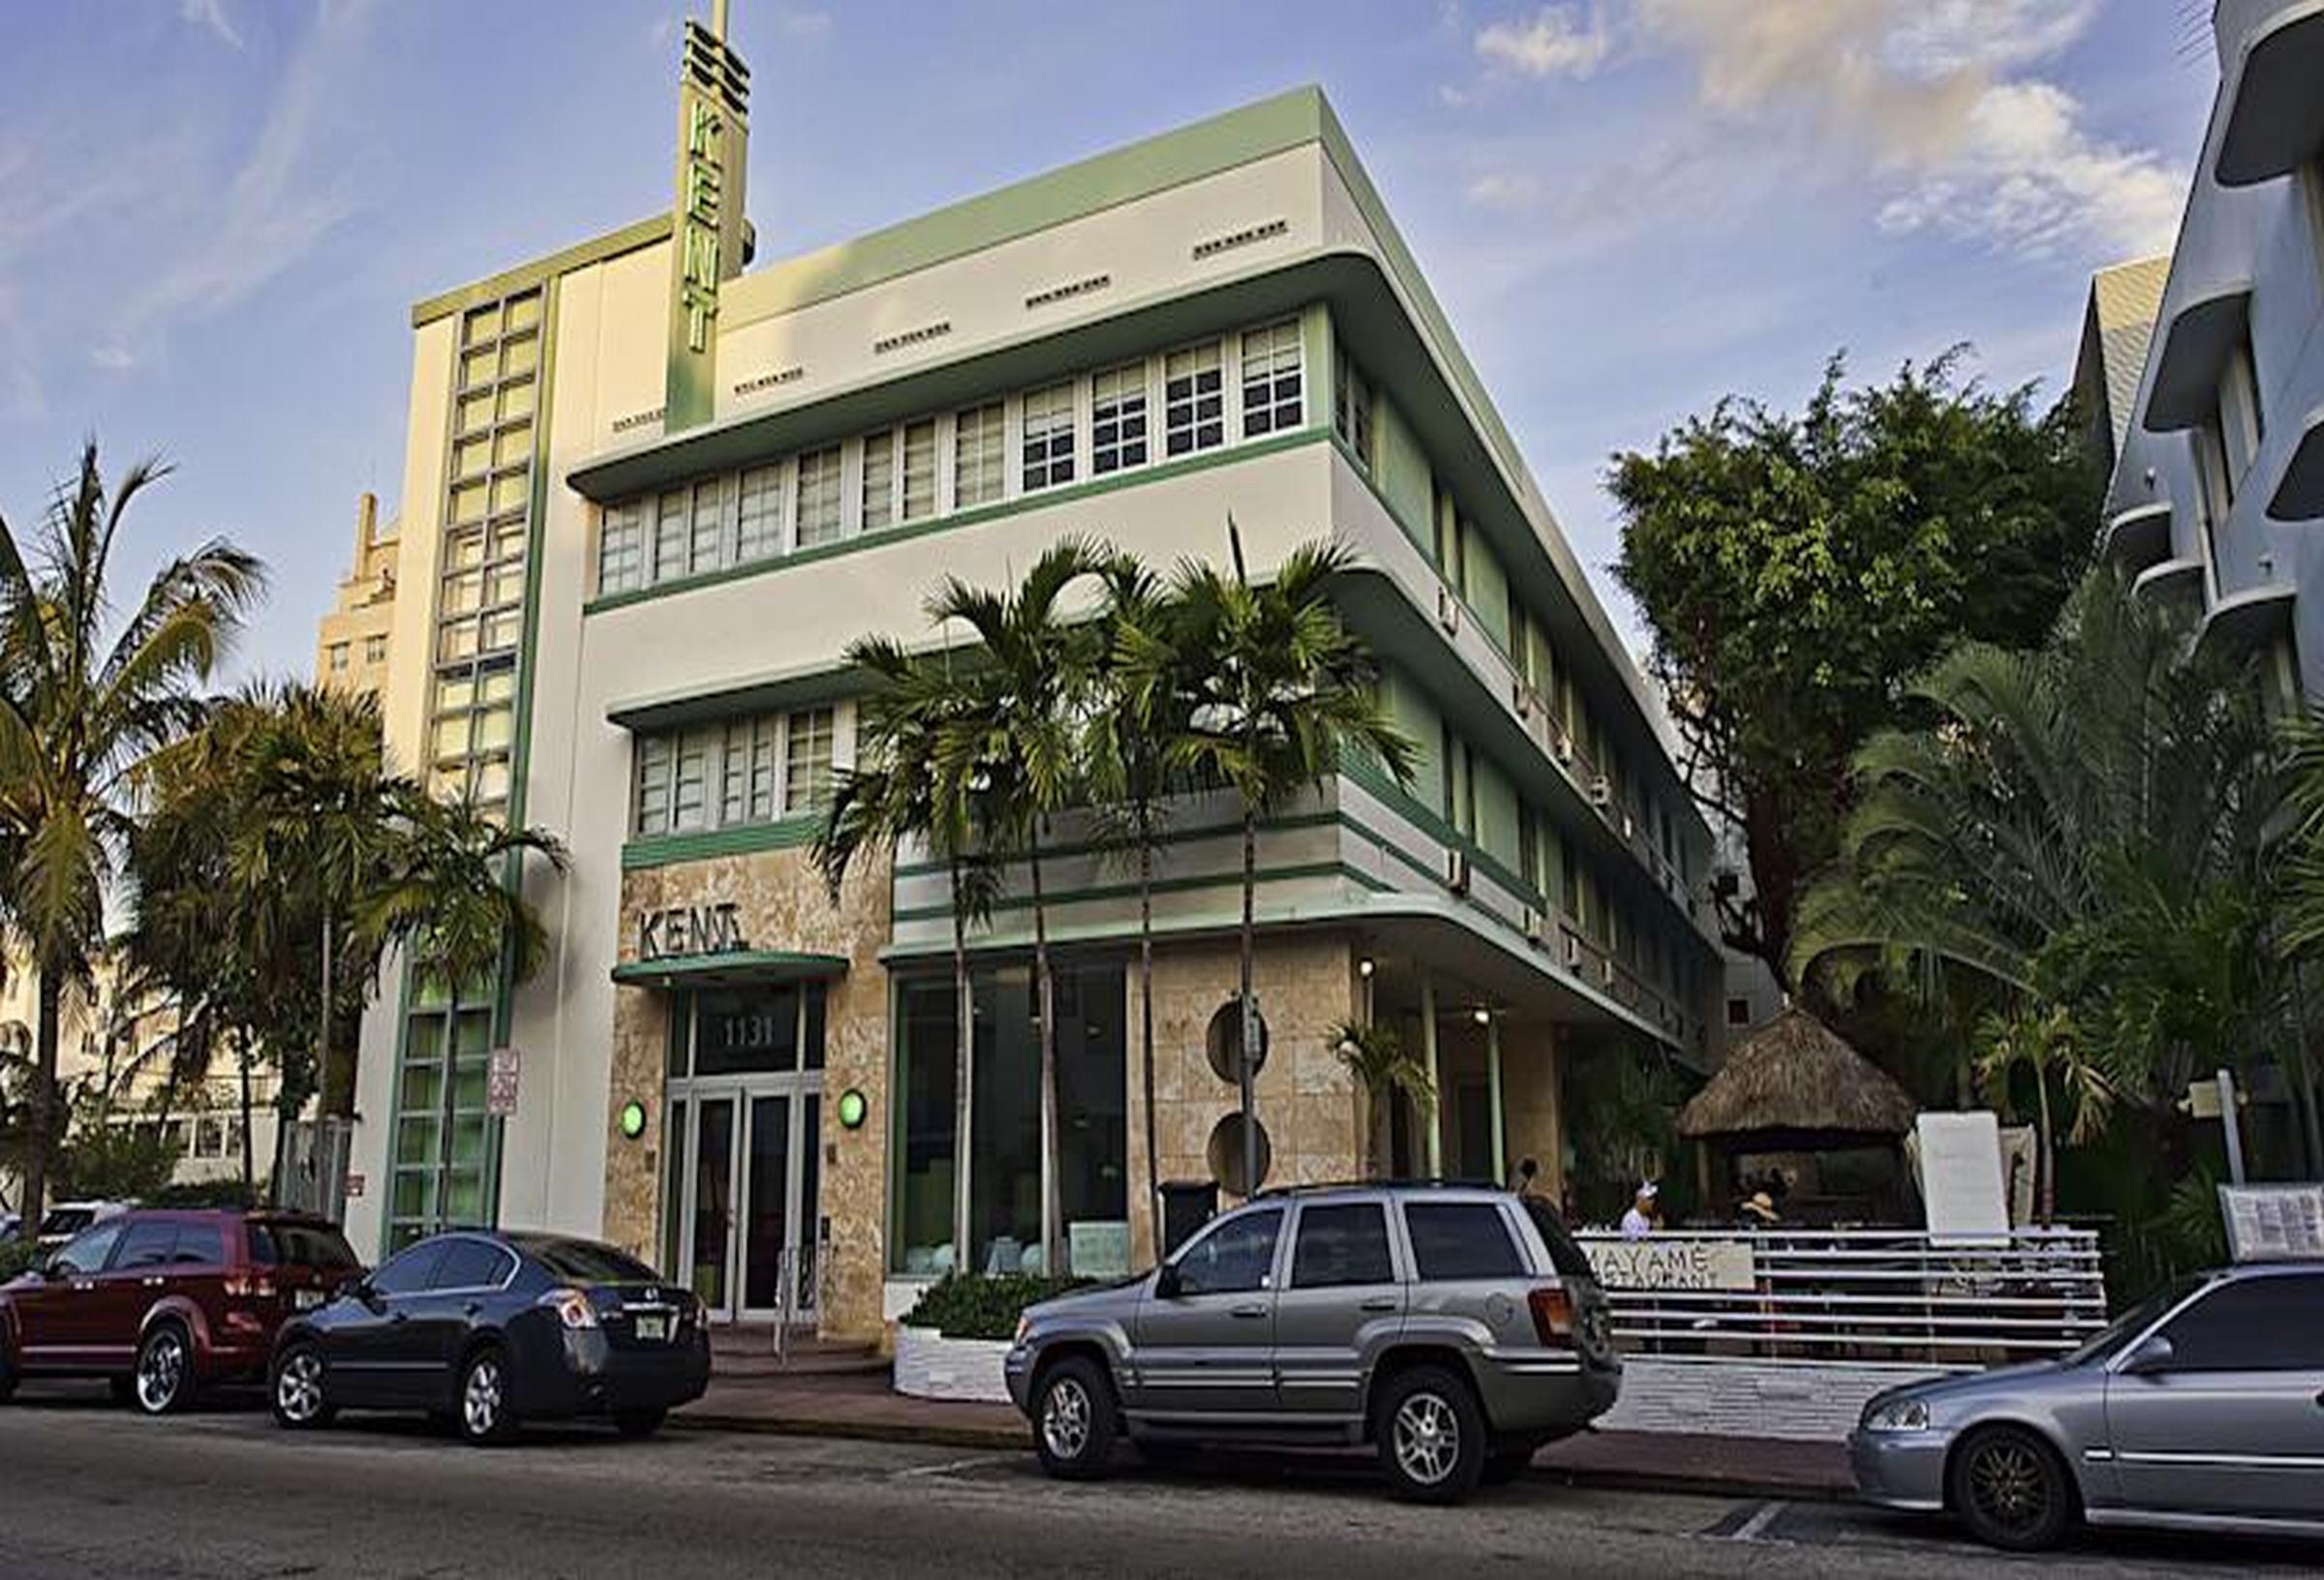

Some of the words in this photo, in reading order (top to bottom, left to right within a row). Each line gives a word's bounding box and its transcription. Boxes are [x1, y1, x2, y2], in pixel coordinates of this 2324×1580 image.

[681, 100, 722, 352] KENT
[639, 902, 748, 959] KENT
[724, 1018, 773, 1047] 1131
